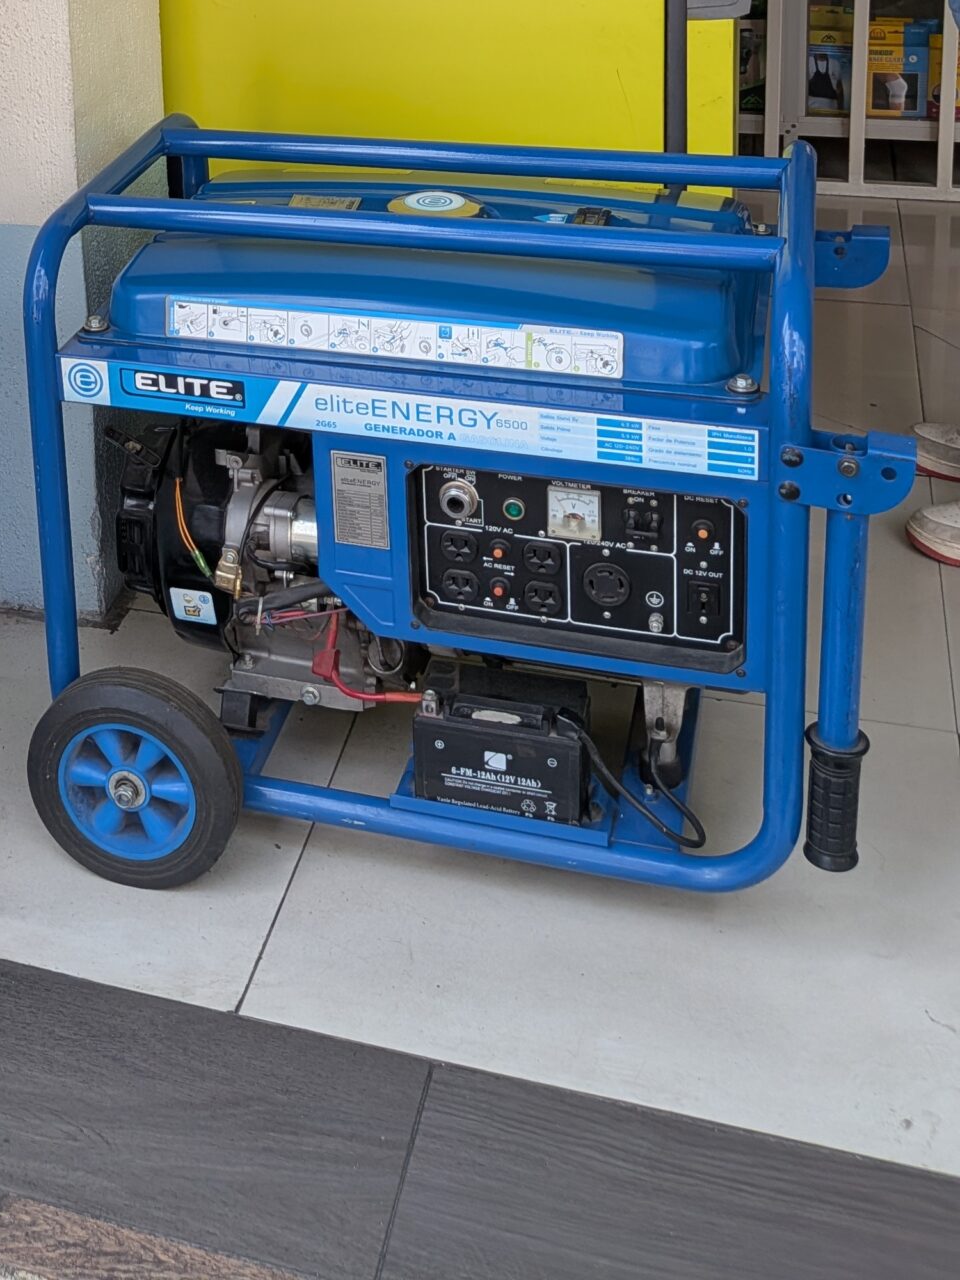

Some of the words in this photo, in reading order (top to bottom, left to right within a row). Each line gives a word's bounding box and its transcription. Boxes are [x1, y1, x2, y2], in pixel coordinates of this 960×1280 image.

[185, 403, 204, 413] Keep
[205, 406, 236, 417] Working
[315, 419, 337, 429] 2G65
[364, 422, 444, 439] GENERADOR
[447, 432, 456, 442] A
[498, 473, 523, 481] POWER
[551, 480, 592, 489] VOLTMETER
[695, 496, 719, 504] RESET
[485, 525, 501, 534] 120V
[502, 527, 513, 535] AC
[494, 563, 515, 571] RESET
[708, 571, 723, 579] OUT
[503, 805, 520, 816] Battery
